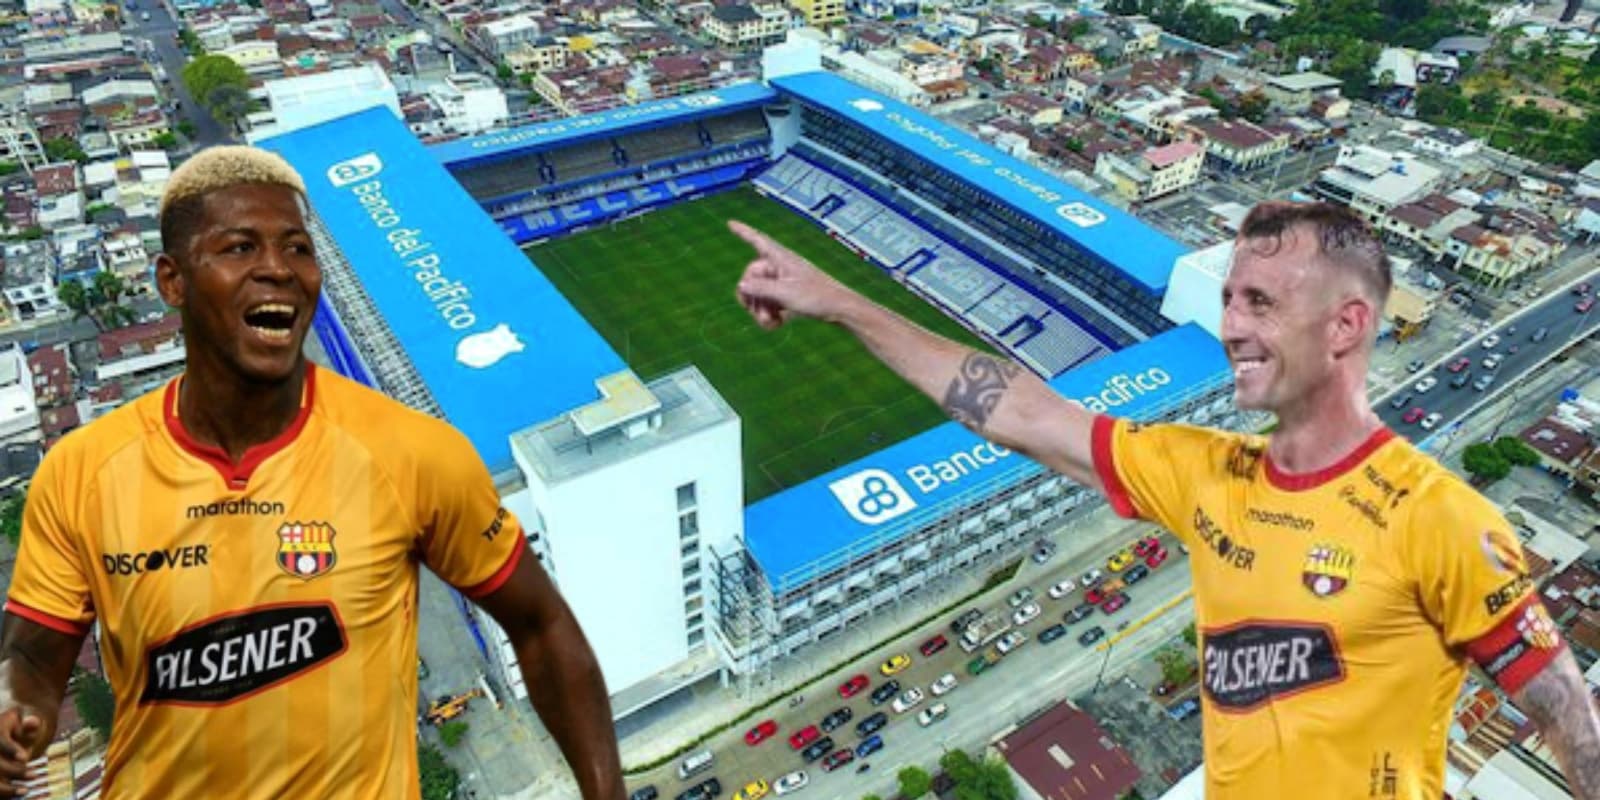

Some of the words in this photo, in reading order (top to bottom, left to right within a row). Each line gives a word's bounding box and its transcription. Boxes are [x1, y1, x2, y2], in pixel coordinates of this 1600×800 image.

[352, 179, 401, 228] Banco
[499, 179, 695, 236] MELEC
[386, 227, 433, 258] del
[405, 253, 477, 330] Pacífico
[906, 443, 1011, 494] Banco
[1067, 367, 1171, 413] acífico
[186, 498, 285, 519] marathon
[1244, 507, 1316, 532] marathon
[102, 544, 209, 576] DISCOVER
[1193, 503, 1256, 572] DISCOVER
[156, 615, 318, 690] PILSENER
[1204, 637, 1313, 694] PILSENER
